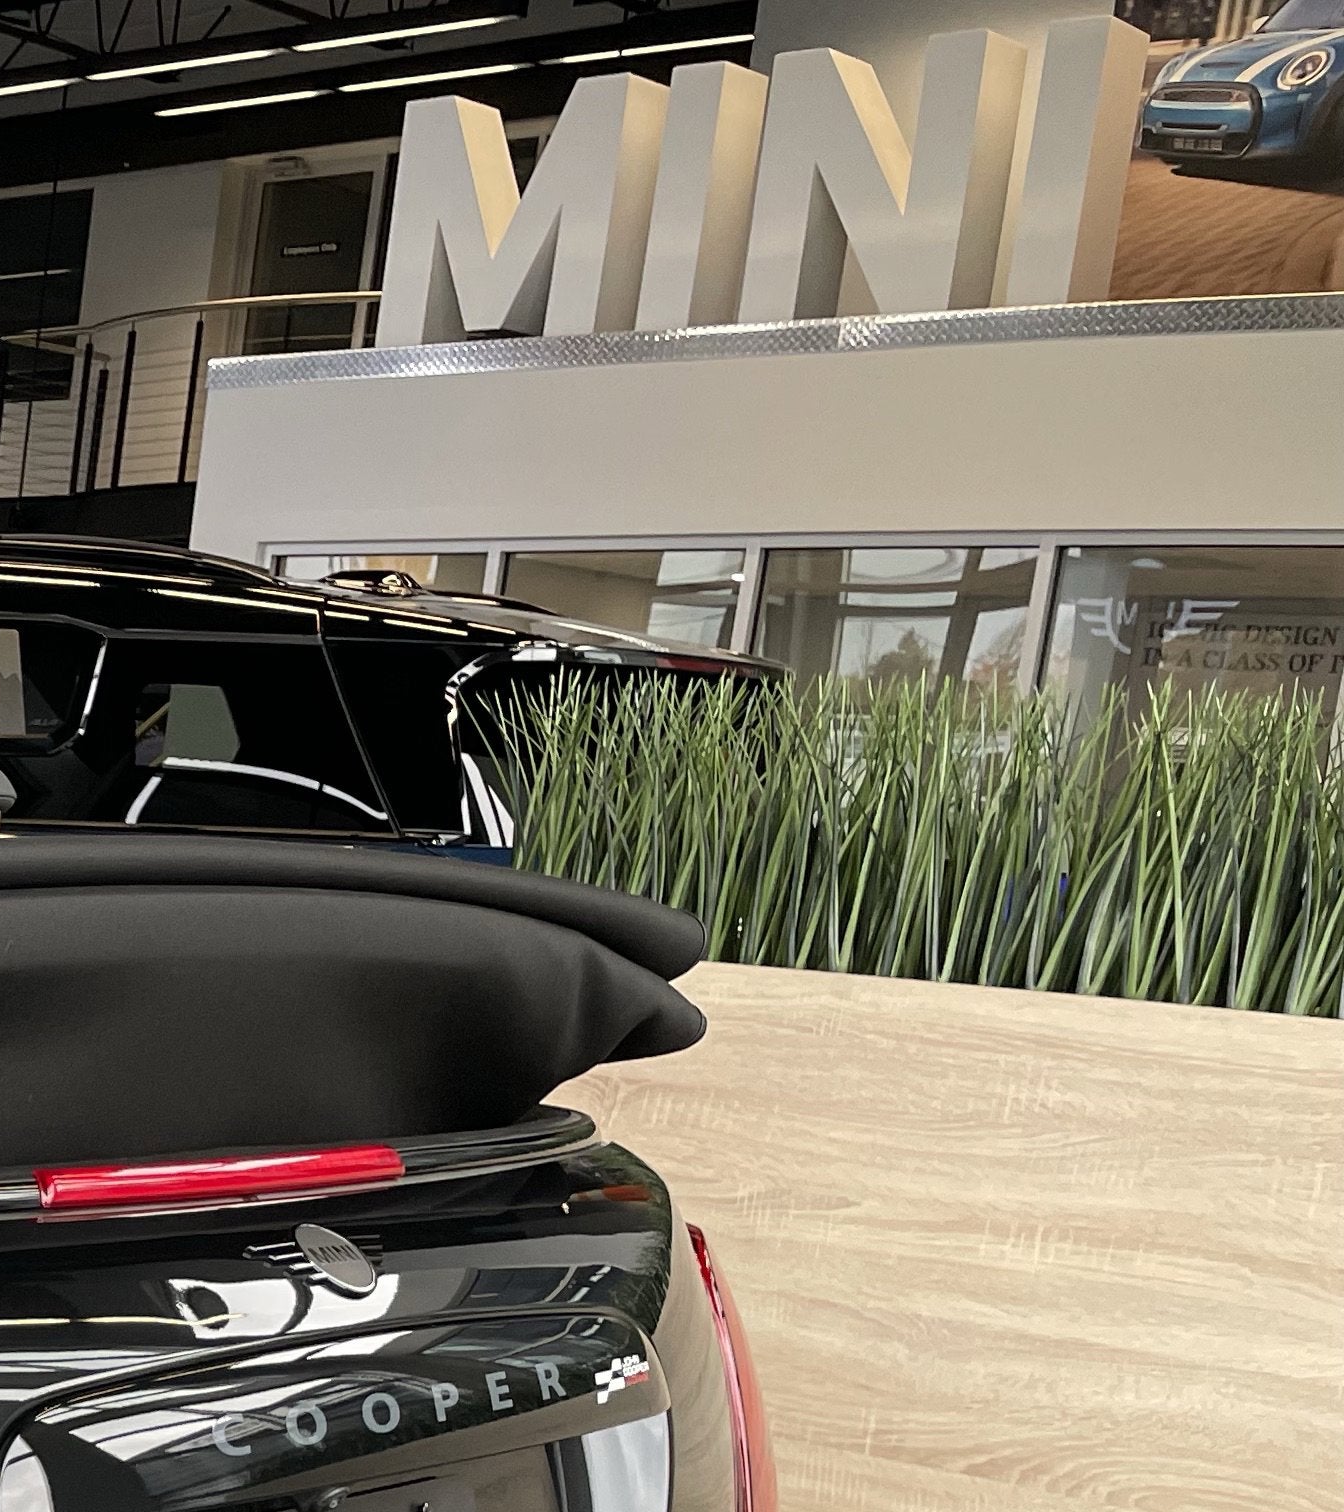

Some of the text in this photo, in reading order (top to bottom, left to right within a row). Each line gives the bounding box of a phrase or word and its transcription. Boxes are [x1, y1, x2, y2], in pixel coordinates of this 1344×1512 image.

[376, 15, 1148, 347] MINI
[1245, 624, 1341, 648] DESIGN
[1176, 650, 1193, 668] A
[1203, 651, 1281, 671] CLASS
[1288, 653, 1325, 673] OF
[307, 1244, 361, 1264] MINI
[211, 1361, 567, 1457] COOPER
